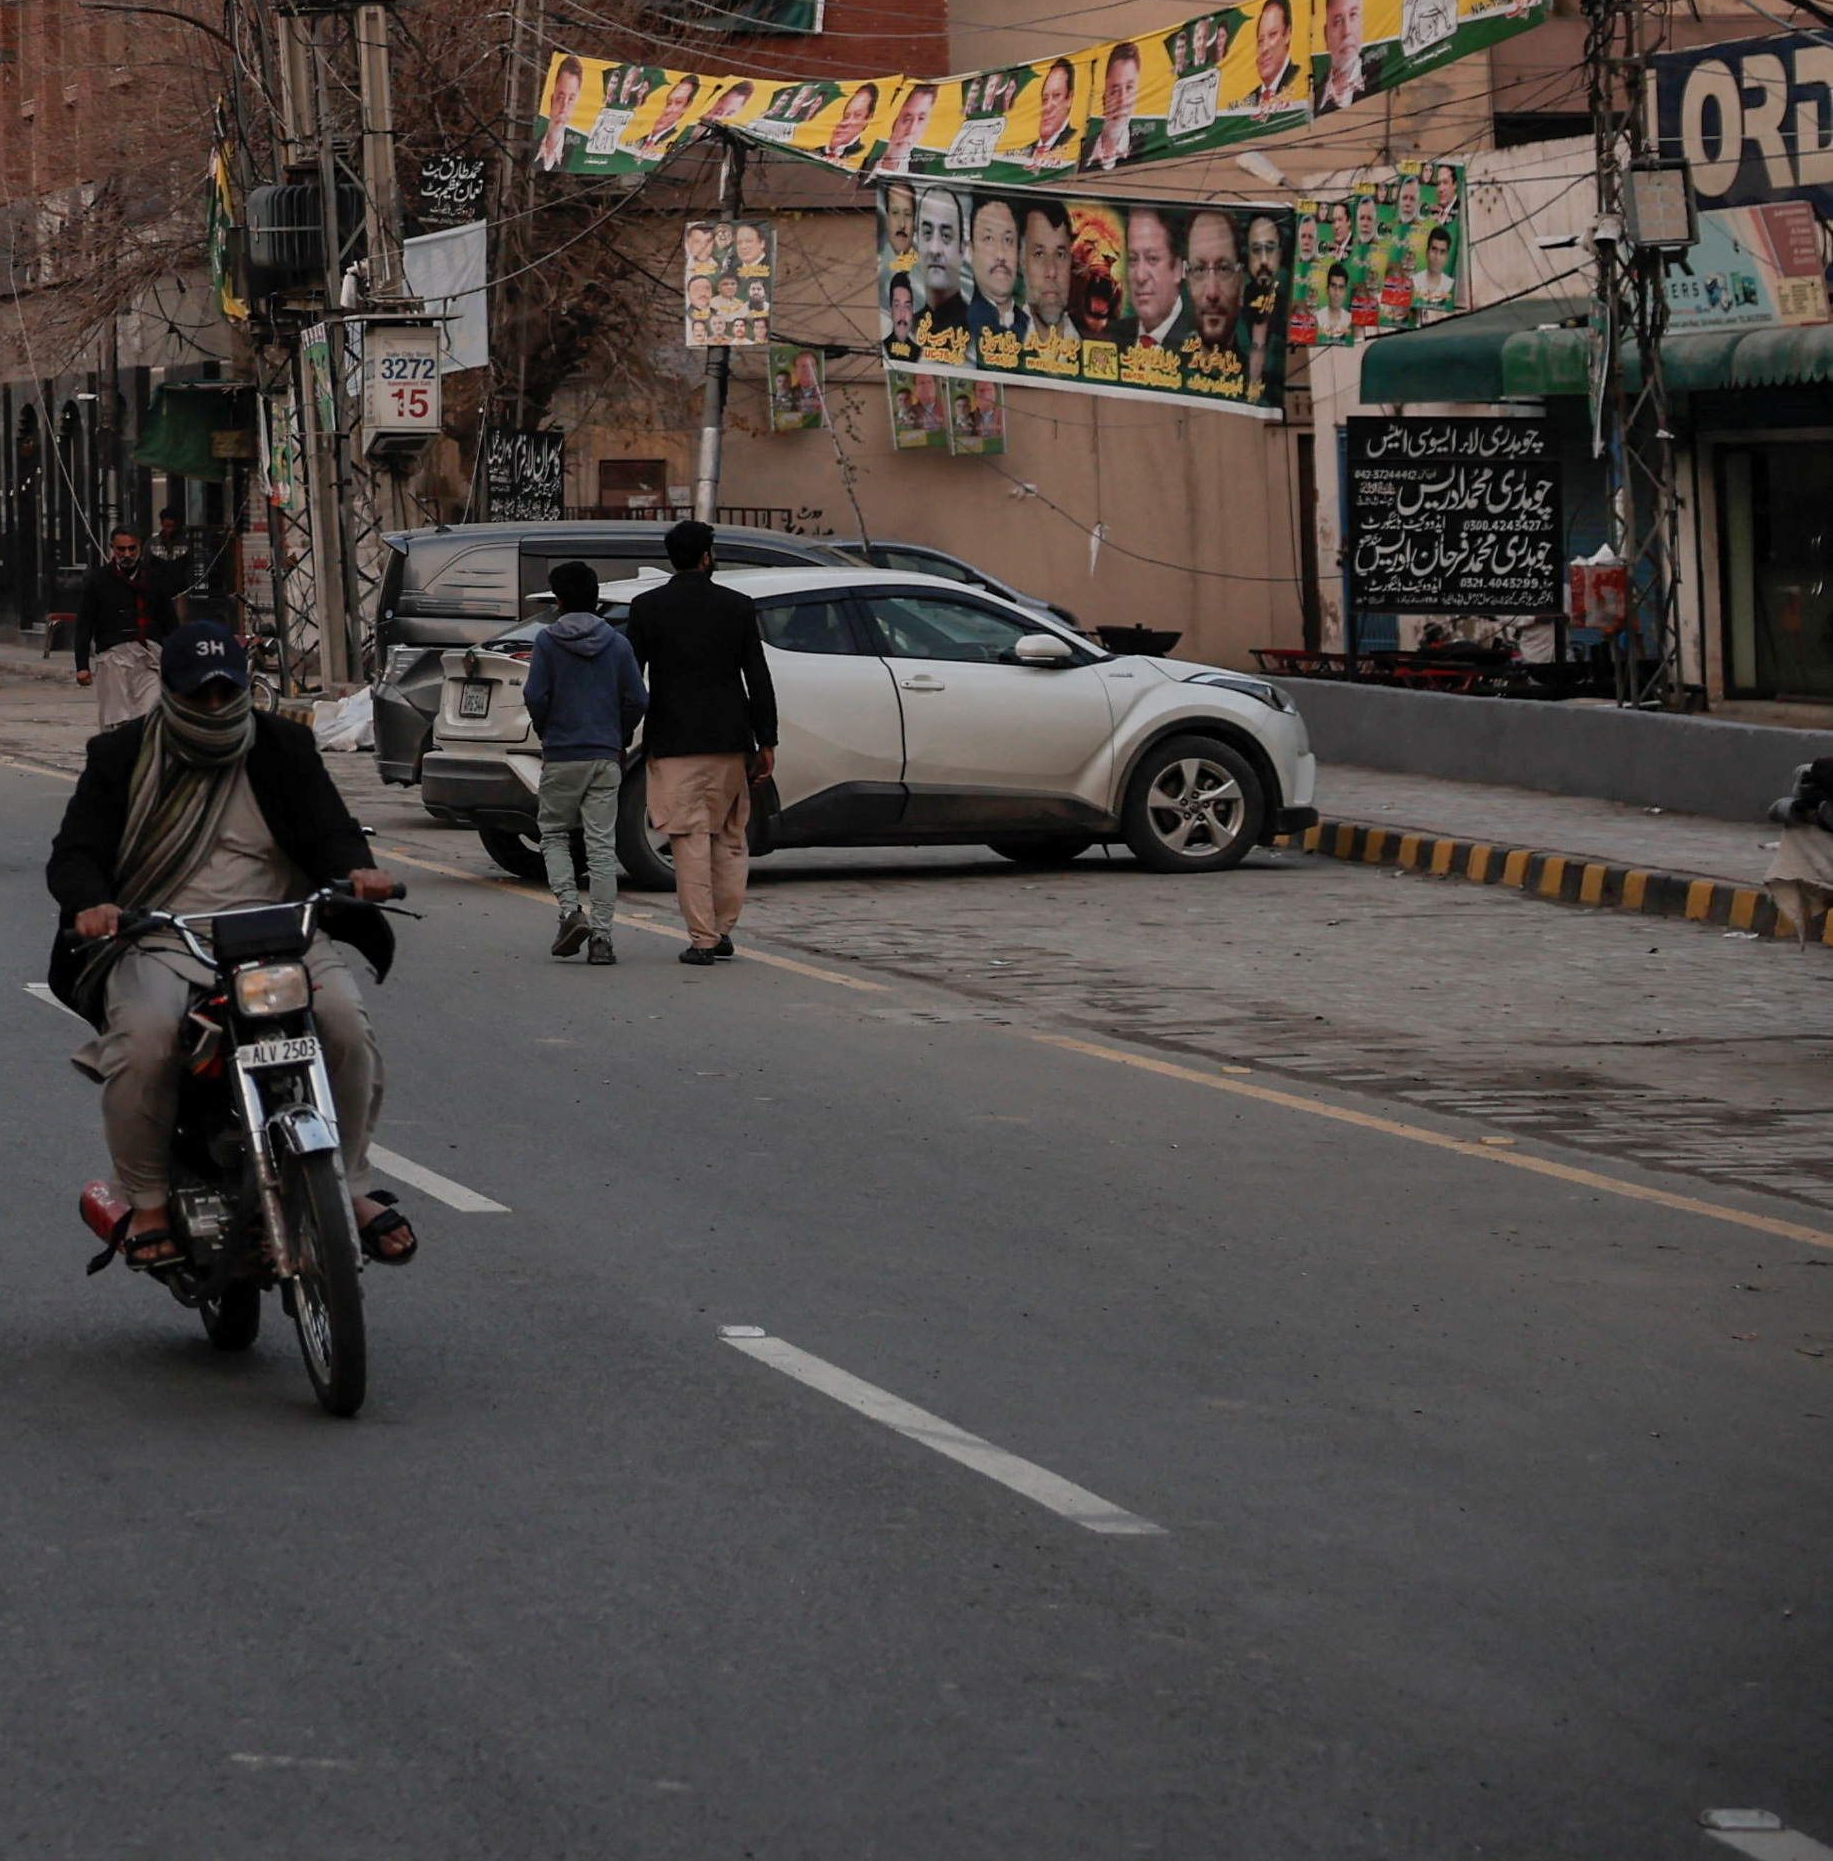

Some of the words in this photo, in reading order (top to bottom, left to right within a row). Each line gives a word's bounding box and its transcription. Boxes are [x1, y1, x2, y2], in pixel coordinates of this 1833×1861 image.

[381, 358, 435, 380] 3272
[391, 388, 429, 418] 15
[195, 638, 226, 657] 3H
[253, 1045, 277, 1063] ALV
[282, 1038, 316, 1060] 2503
